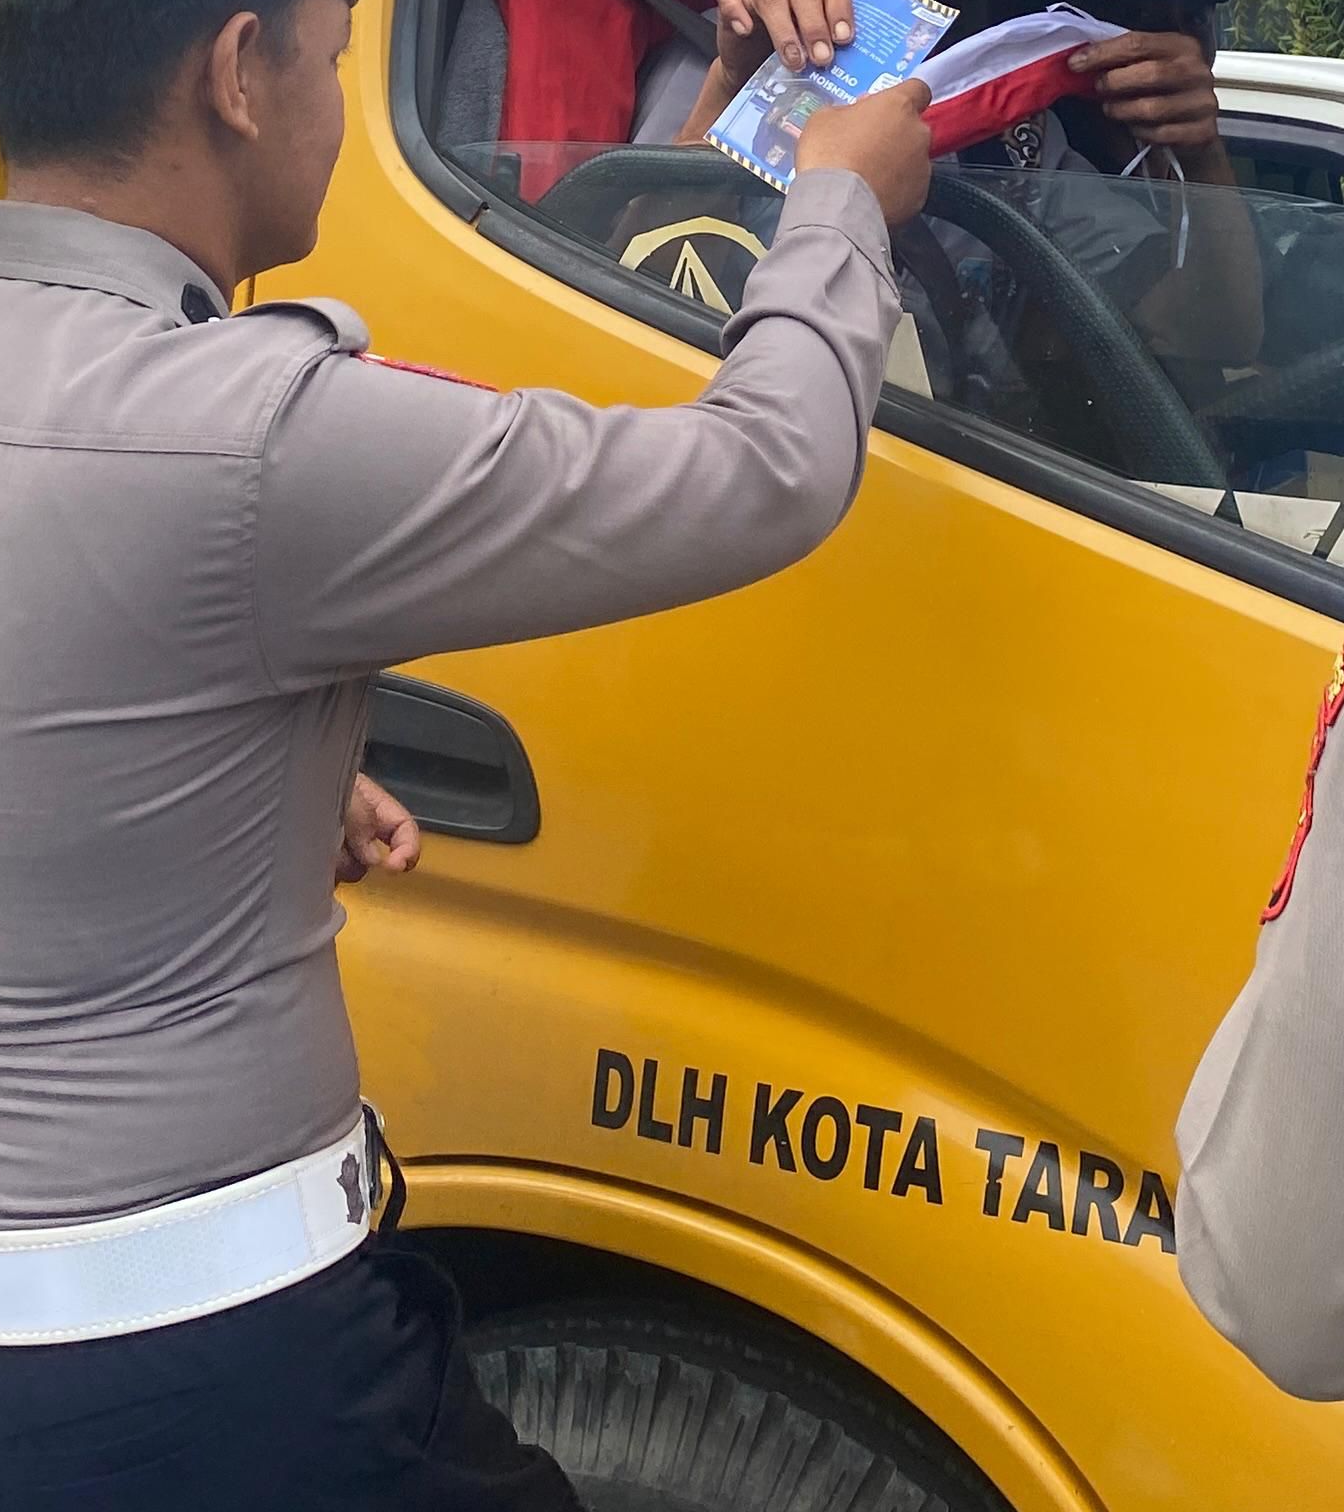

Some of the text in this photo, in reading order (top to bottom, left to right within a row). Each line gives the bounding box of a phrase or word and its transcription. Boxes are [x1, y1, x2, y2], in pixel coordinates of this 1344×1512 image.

[809, 71, 857, 105] IMENSION
[830, 65, 858, 87] OVER
[591, 1048, 1177, 1255] DLH KOTA TARA
